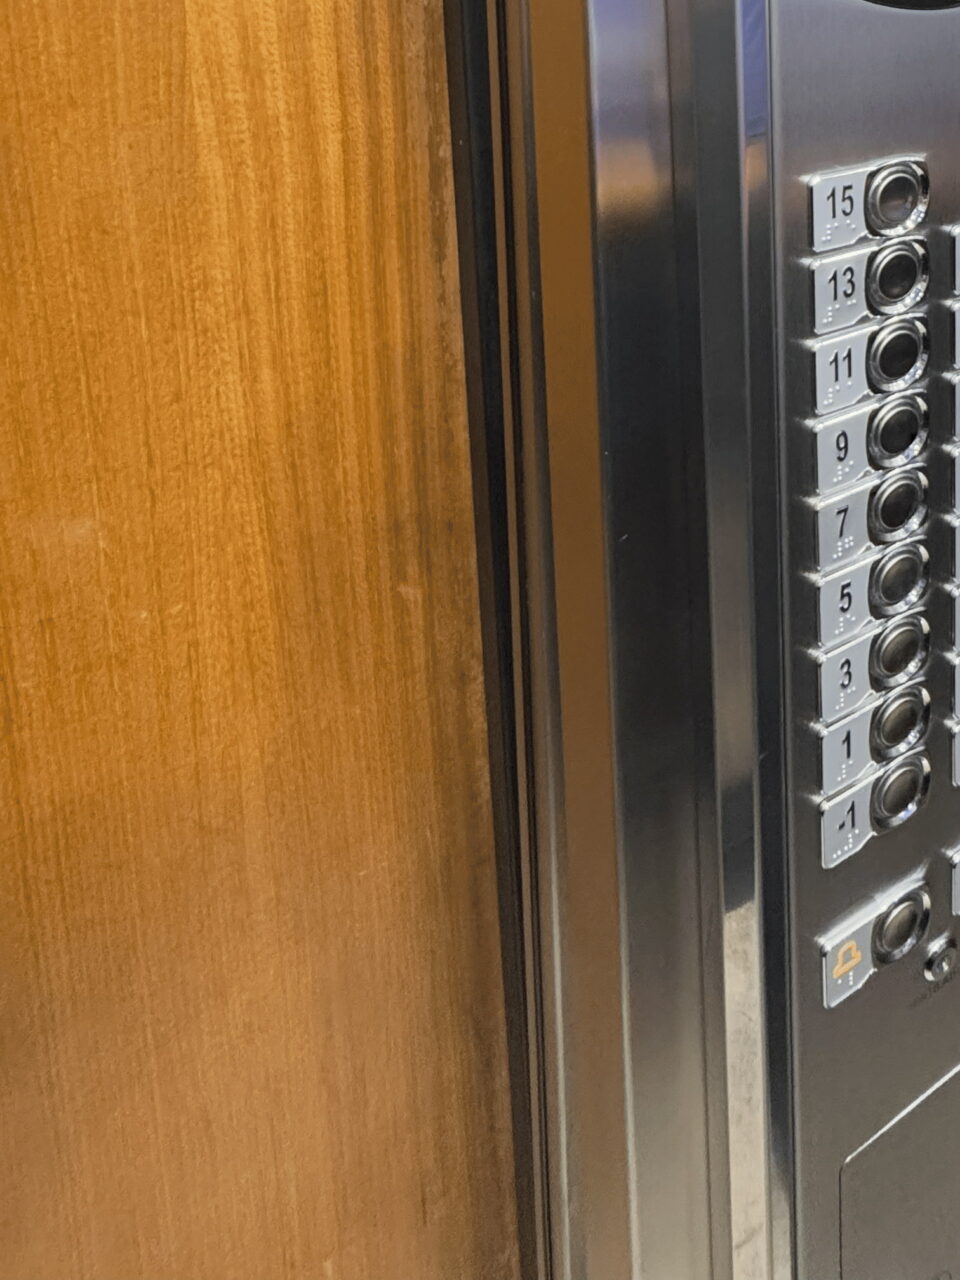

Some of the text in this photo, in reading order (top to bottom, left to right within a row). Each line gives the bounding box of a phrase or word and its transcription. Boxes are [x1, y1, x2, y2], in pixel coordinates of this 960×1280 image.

[827, 184, 854, 219] 15
[828, 266, 856, 301] 13
[829, 347, 852, 383] 11
[836, 431, 849, 462] 9
[836, 505, 849, 538] 7
[839, 582, 852, 613] 5
[839, 658, 851, 689] 3
[842, 730, 851, 760] 1
[838, 800, 856, 831] -1
